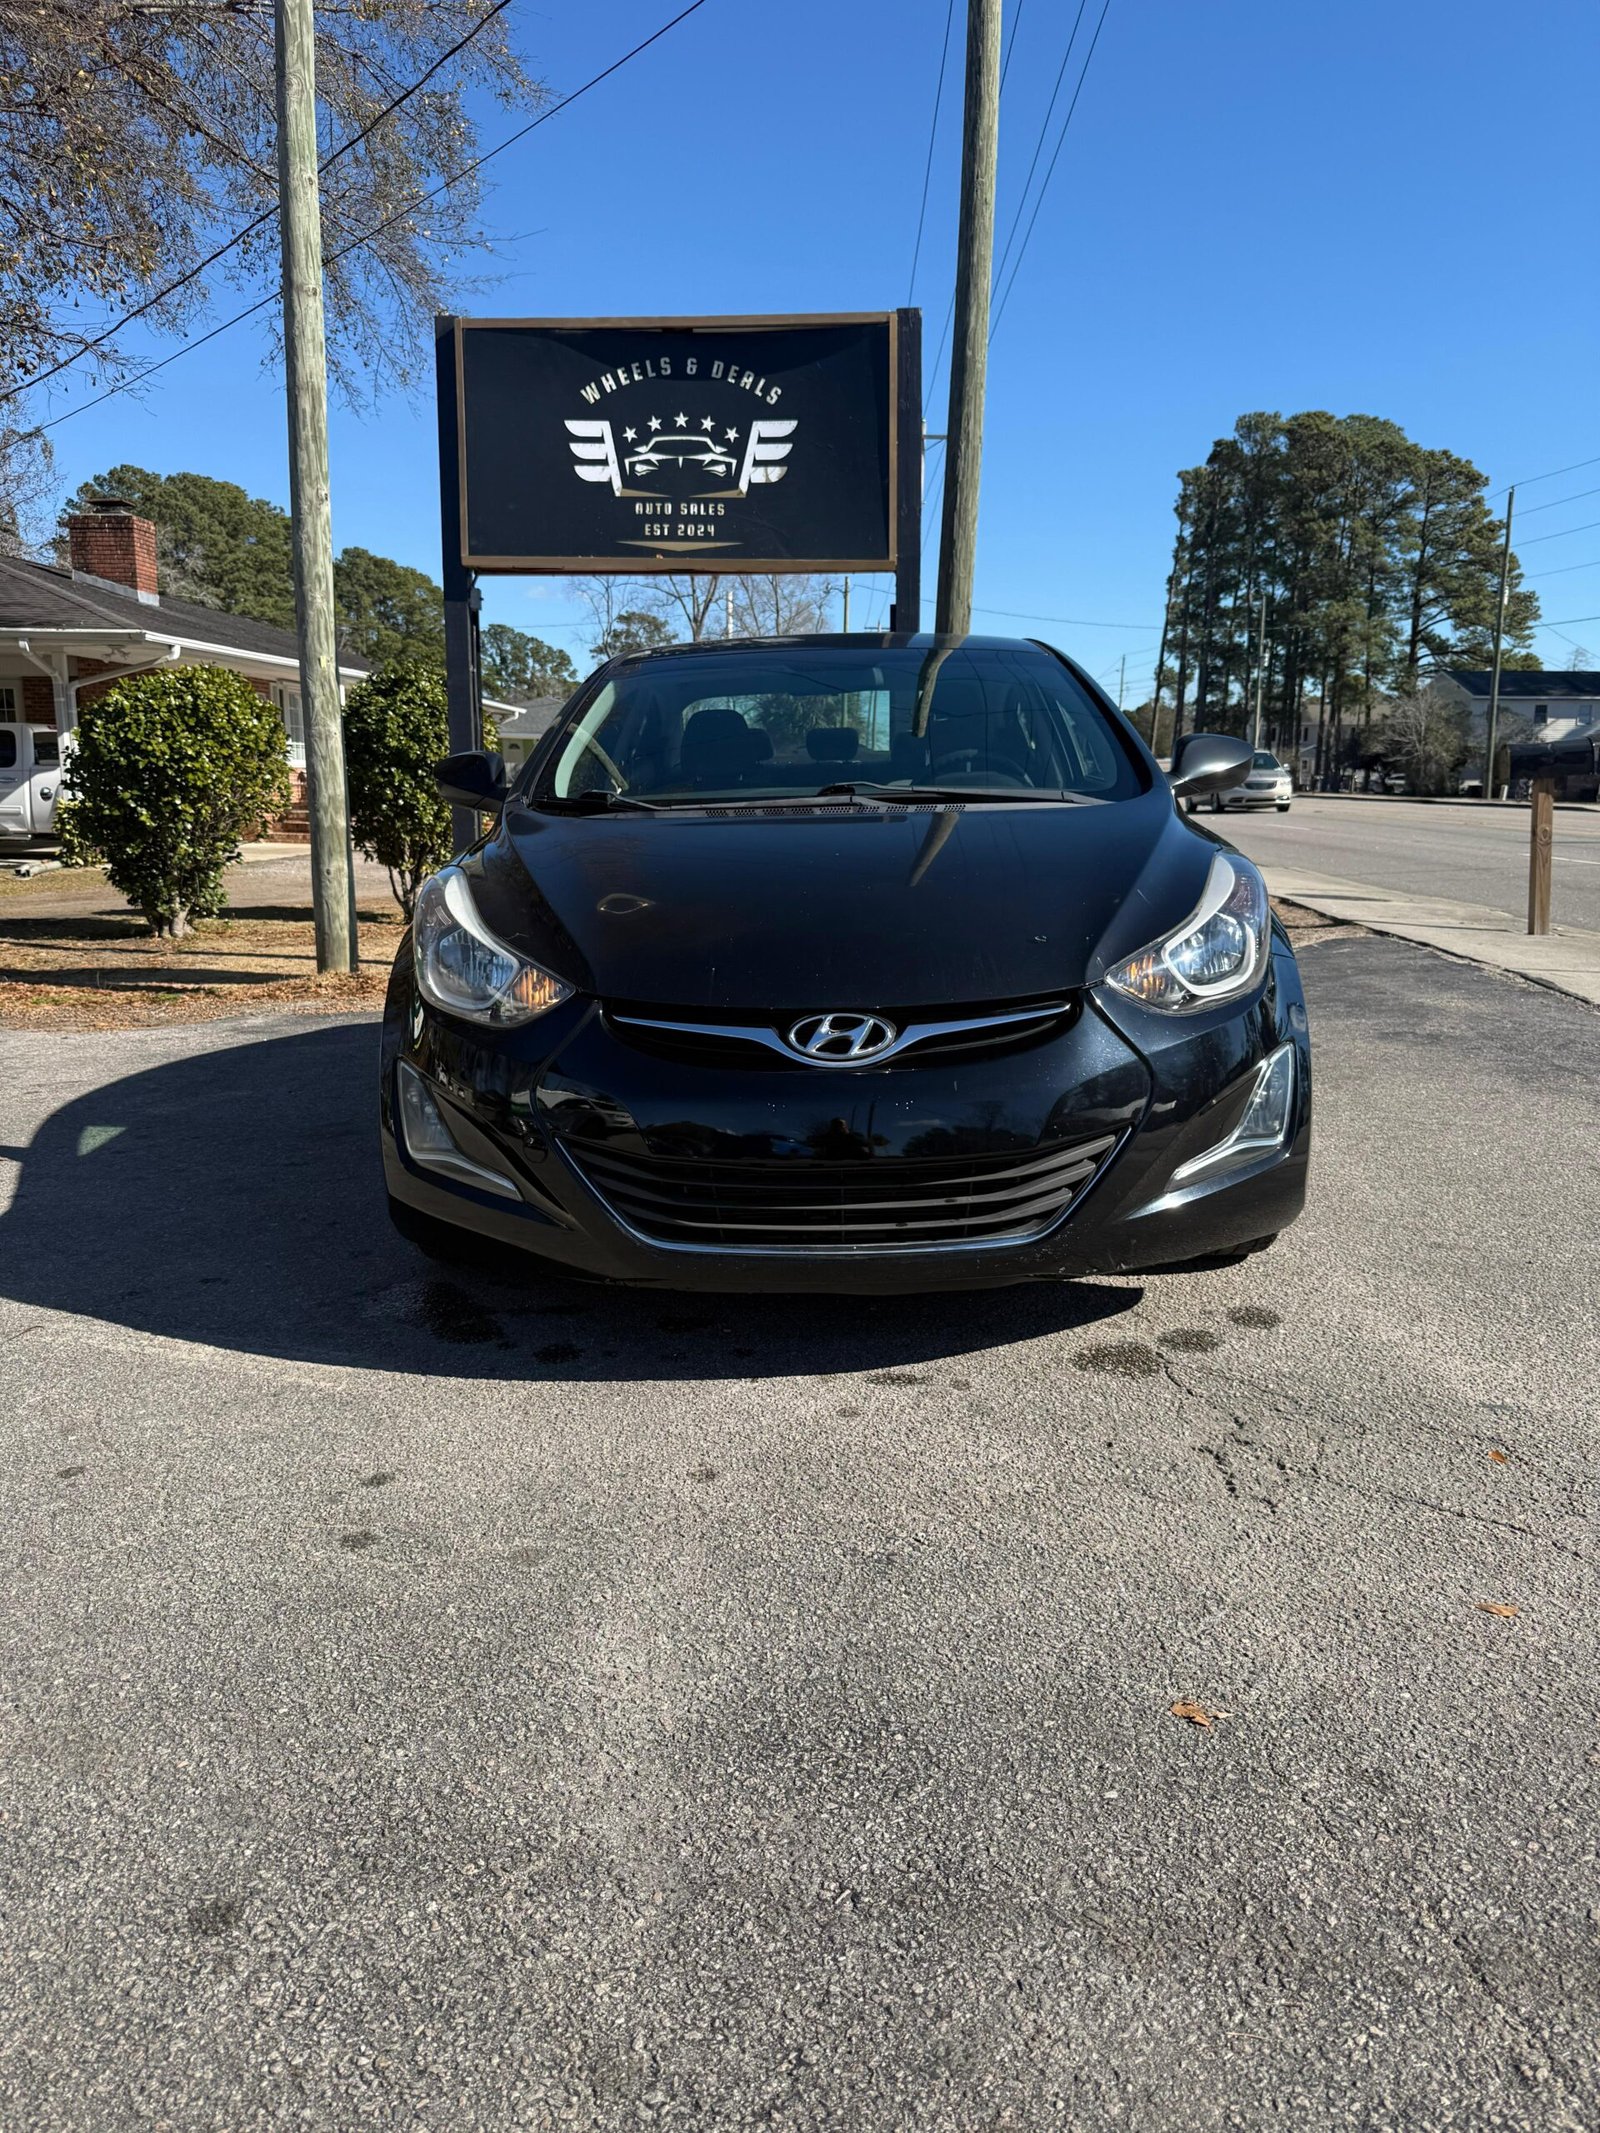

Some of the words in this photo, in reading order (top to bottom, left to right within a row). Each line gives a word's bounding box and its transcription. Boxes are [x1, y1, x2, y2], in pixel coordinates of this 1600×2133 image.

[580, 357, 672, 405] WHEELS
[686, 357, 698, 375] &
[711, 360, 782, 405] DEALS
[635, 502, 672, 516] AUTO
[680, 503, 726, 516] SALES
[644, 523, 670, 536] EST
[677, 523, 715, 537] 2024
